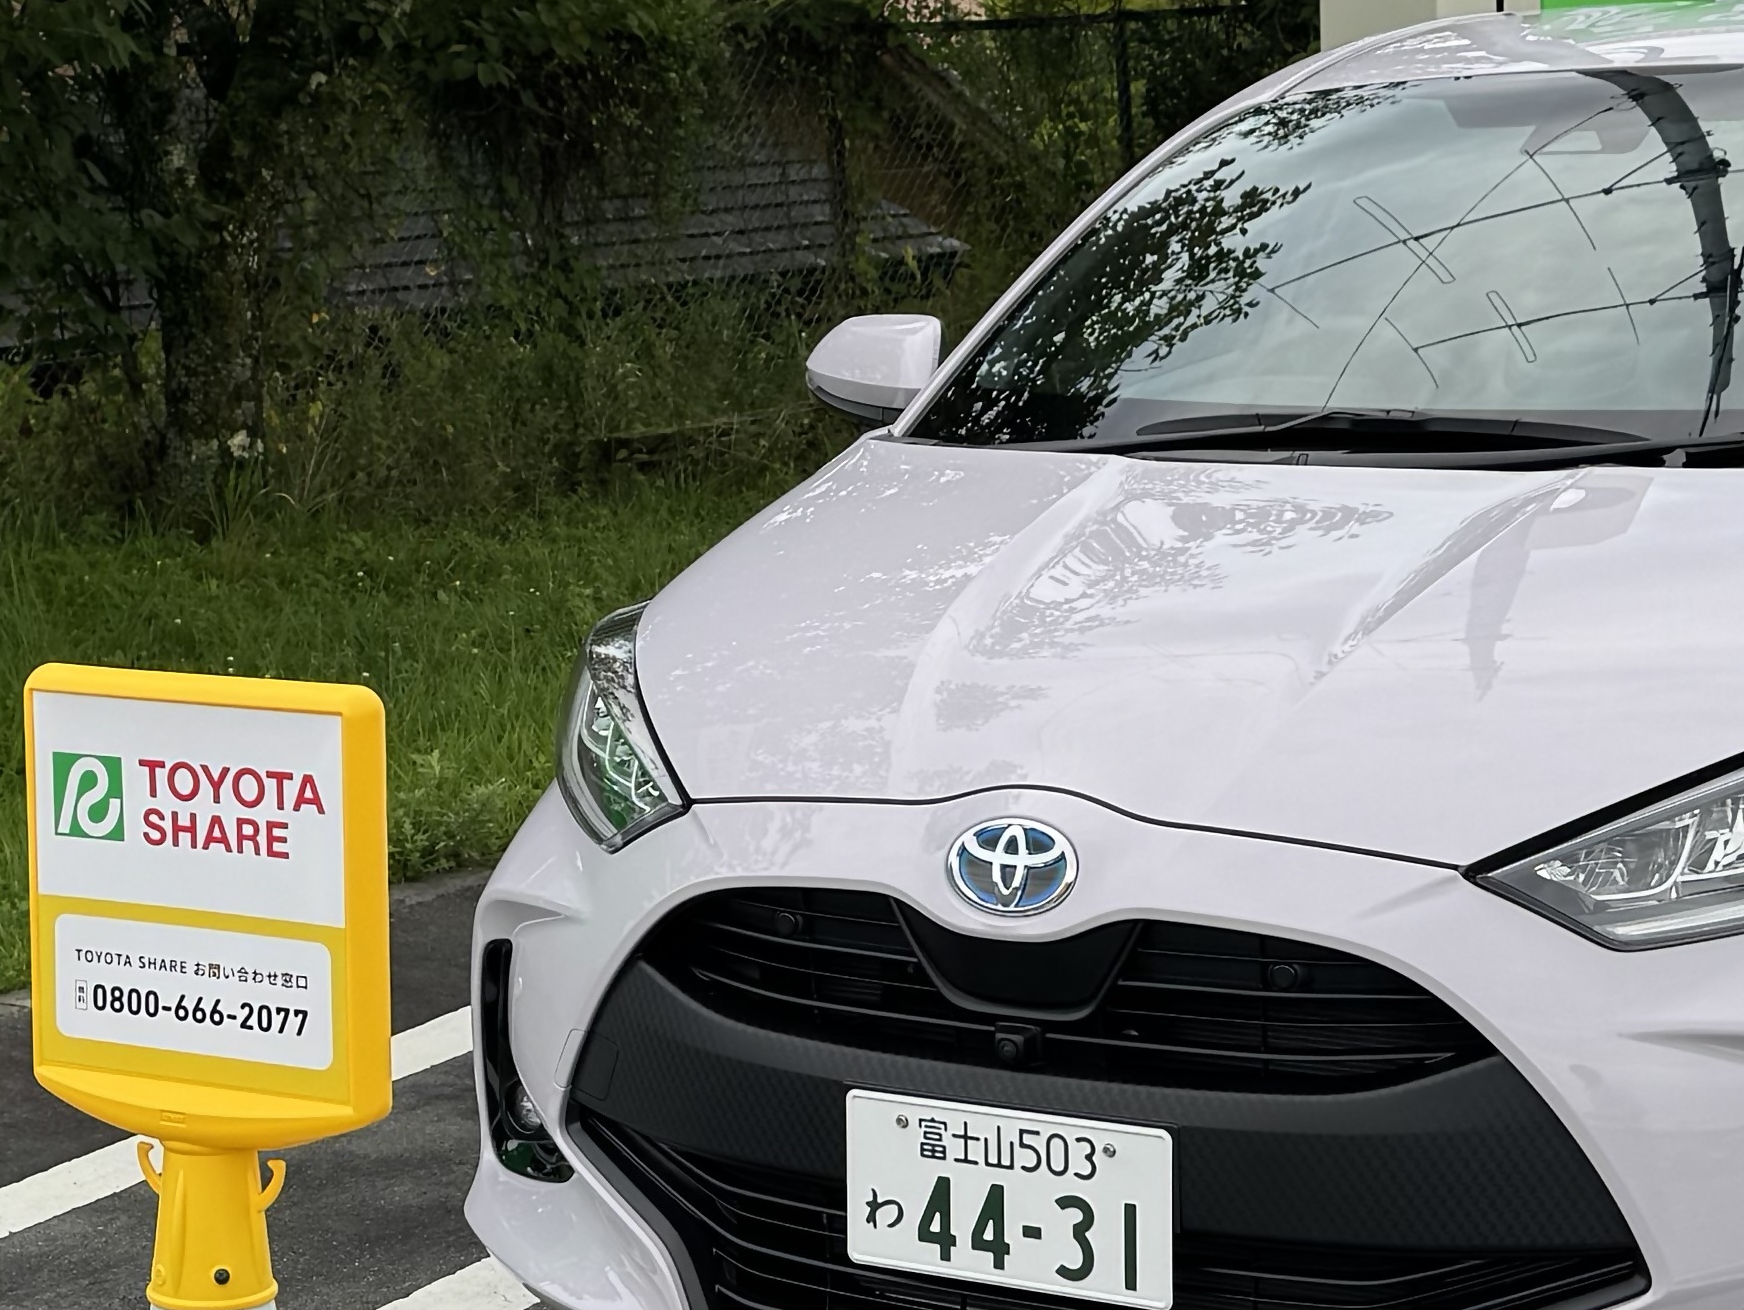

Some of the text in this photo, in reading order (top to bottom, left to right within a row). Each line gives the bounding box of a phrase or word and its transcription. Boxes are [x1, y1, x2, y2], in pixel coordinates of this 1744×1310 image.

[138, 758, 326, 815] TOYOTA
[141, 806, 290, 860] SHARE
[74, 948, 309, 990] TOYOTA SHARE お問い合わせ窓口
[92, 983, 310, 1038] 0800-666-2077
[865, 1175, 1139, 1293] わ 44-31
